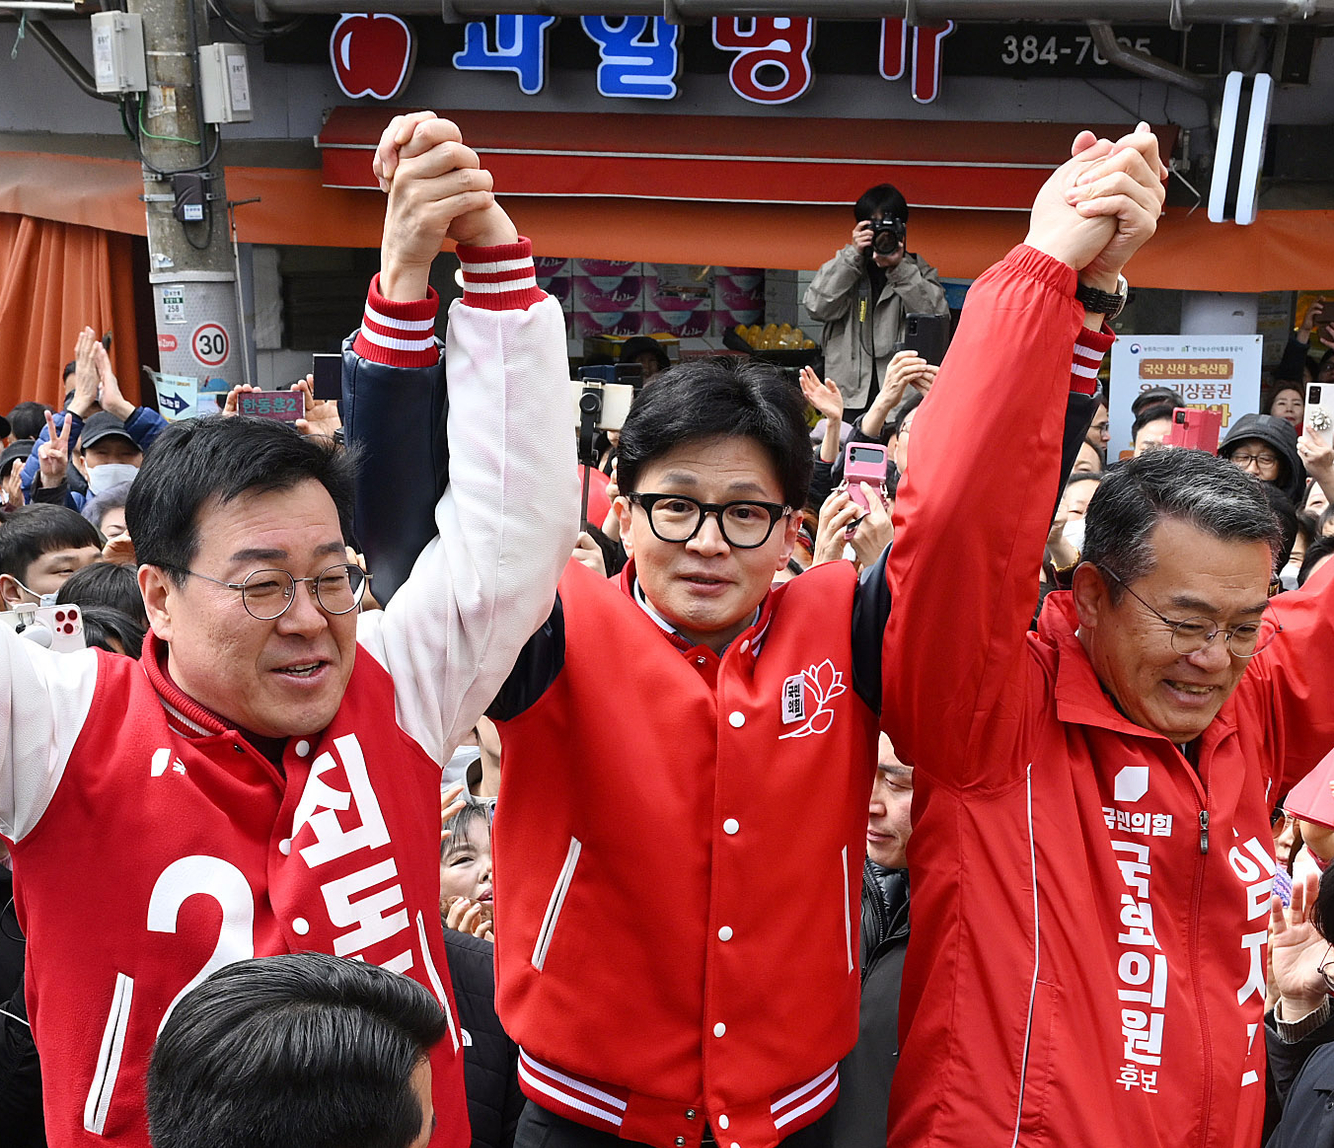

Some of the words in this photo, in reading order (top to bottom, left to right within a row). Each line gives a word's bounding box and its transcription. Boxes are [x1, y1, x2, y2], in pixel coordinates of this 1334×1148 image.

[1001, 34, 1152, 66] 384-705
[167, 304, 180, 313] 258
[198, 333, 225, 355] 30
[1143, 363, 1163, 375] 국산
[1166, 363, 1186, 375] 신선
[1188, 363, 1229, 375] 농축산물
[1101, 806, 1174, 837] 국민의힘
[147, 854, 255, 1040] 2
[1110, 839, 1167, 1067] 국회의원
[1115, 1064, 1159, 1094] 후보
